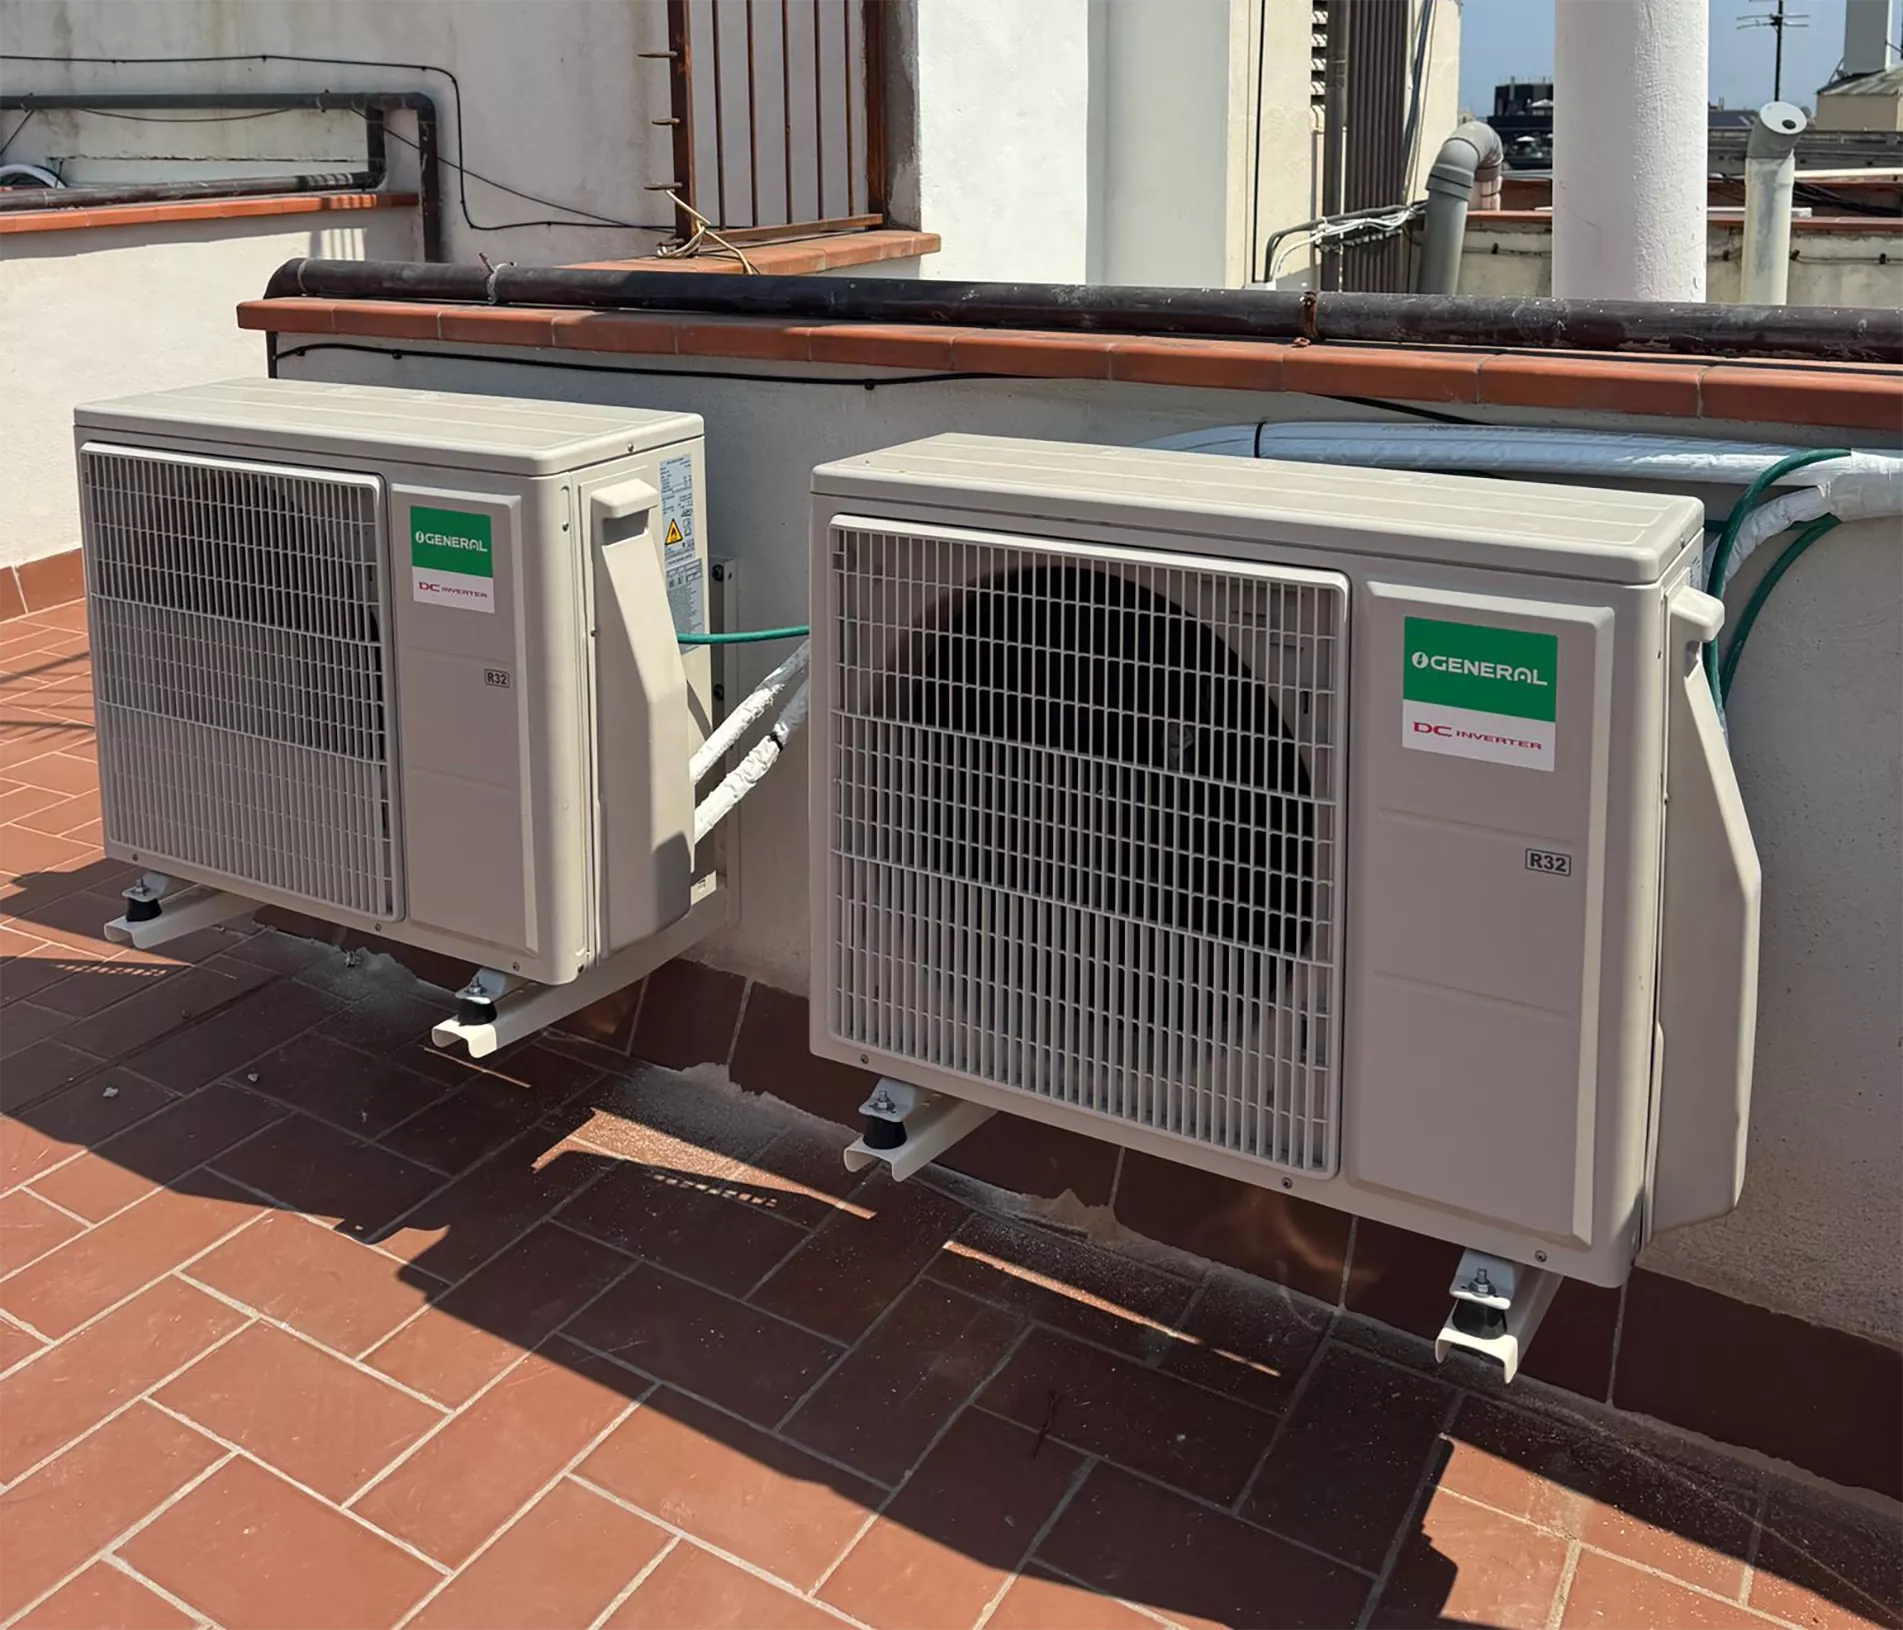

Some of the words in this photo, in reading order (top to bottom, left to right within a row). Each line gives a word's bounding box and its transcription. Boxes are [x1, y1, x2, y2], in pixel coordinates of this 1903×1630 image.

[419, 582, 440, 592] DC
[442, 587, 487, 598] INVERTER
[488, 672, 507, 685] R32
[1414, 722, 1452, 737] DC
[1456, 730, 1542, 750] INVERTER
[1530, 853, 1567, 872] R32
